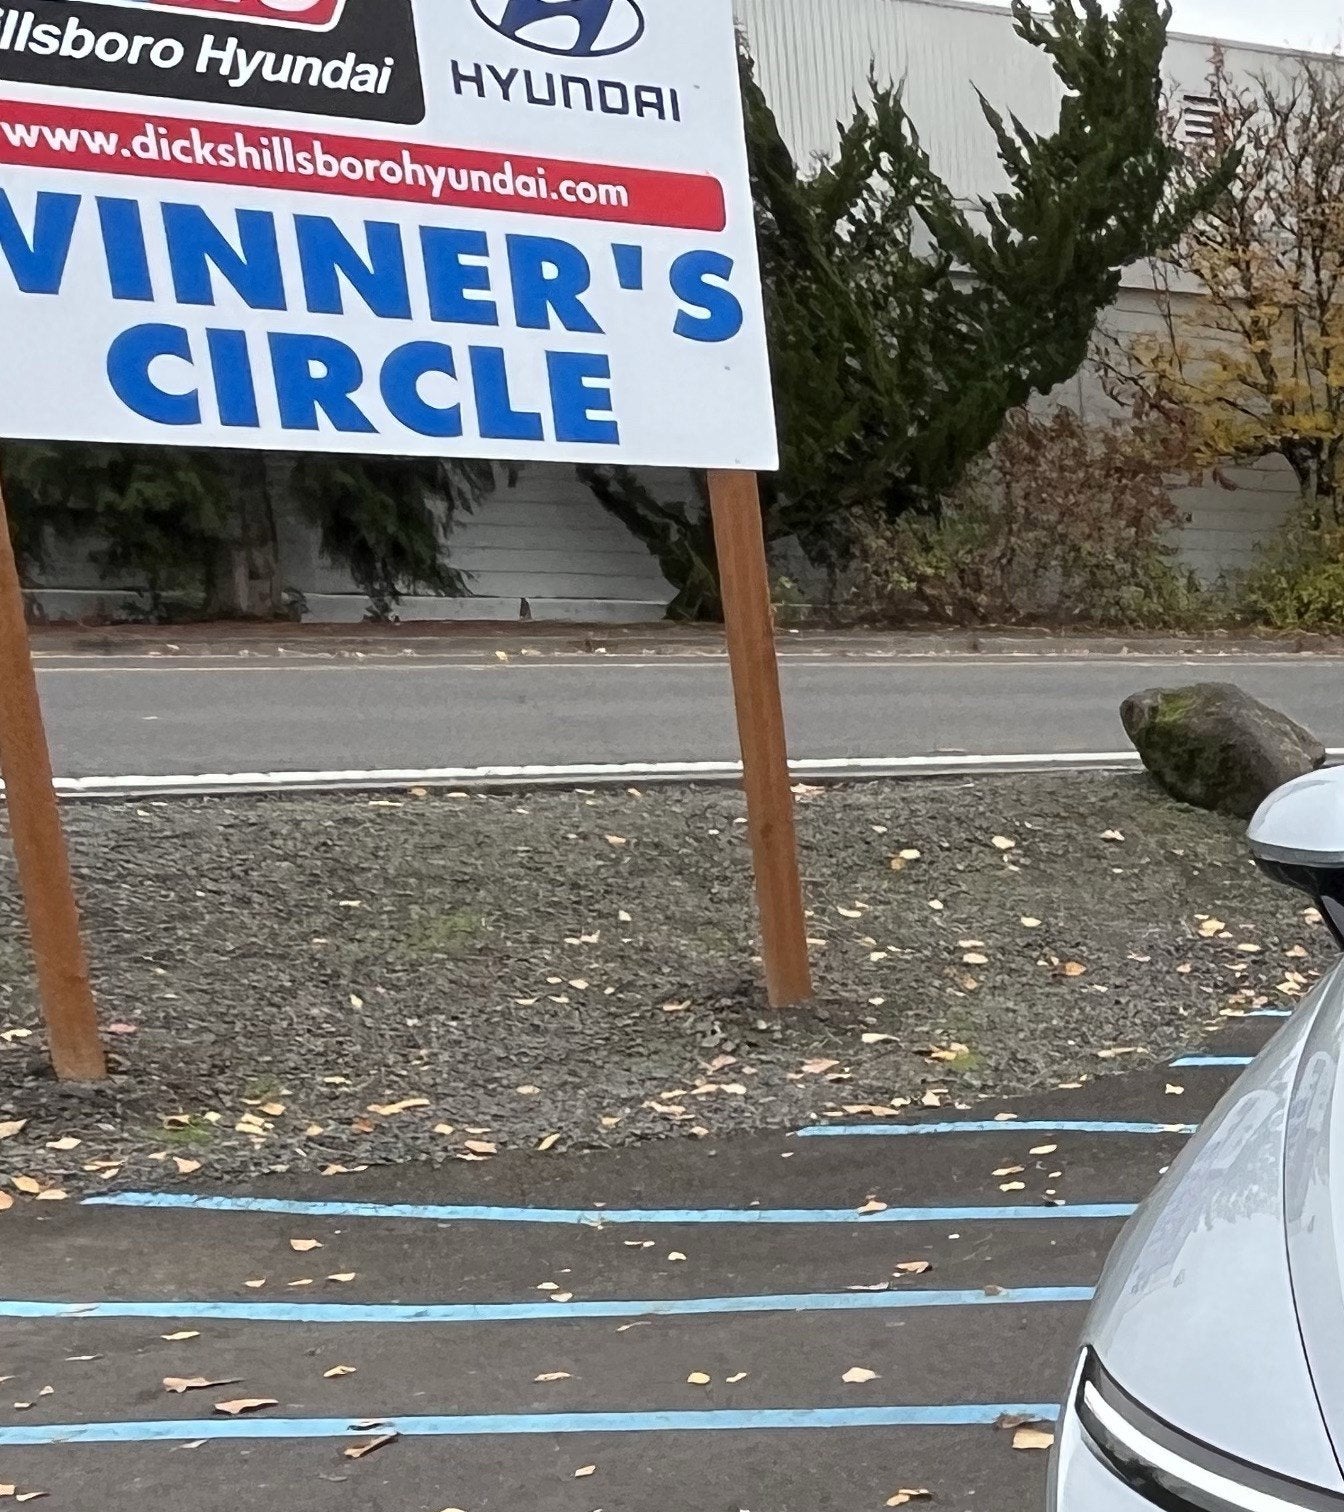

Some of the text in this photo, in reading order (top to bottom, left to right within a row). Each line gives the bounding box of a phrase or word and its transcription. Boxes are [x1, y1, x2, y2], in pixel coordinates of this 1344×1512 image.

[195, 33, 394, 94] Hyundai
[451, 60, 681, 122] HYUNDAI
[0, 121, 629, 208] www.dickshillsborohyundai.com
[106, 323, 620, 445] CIRCLE
